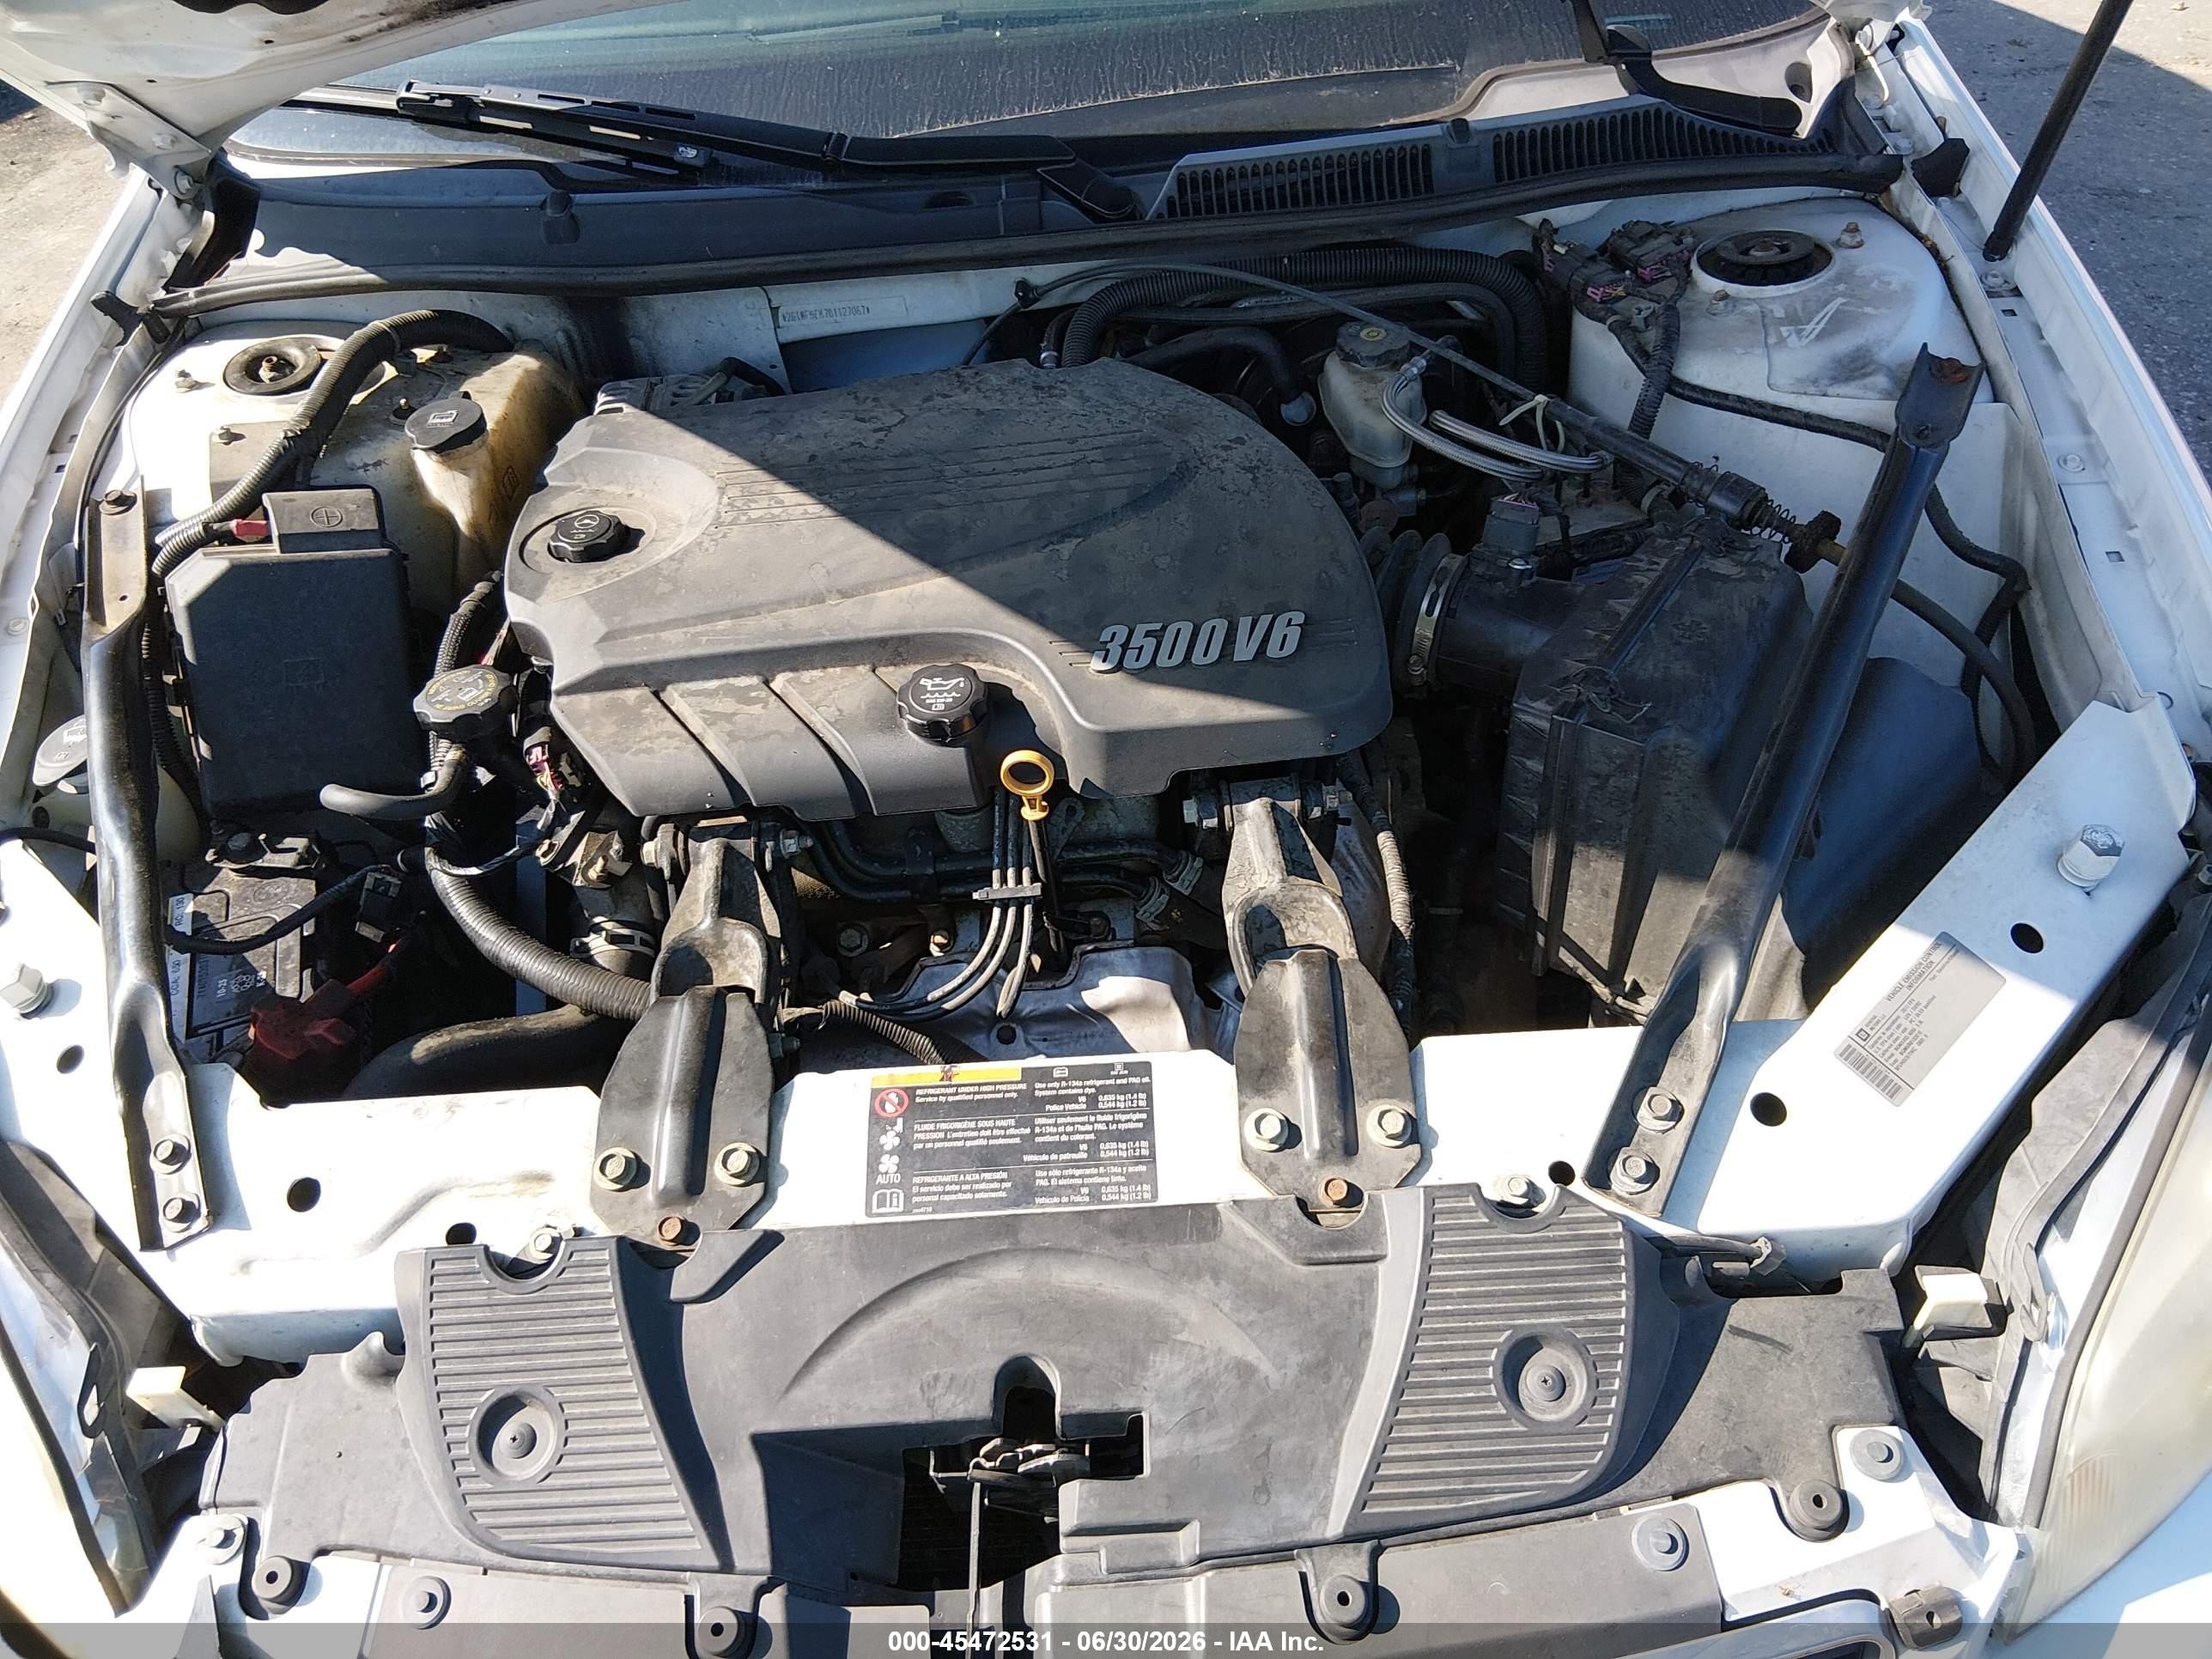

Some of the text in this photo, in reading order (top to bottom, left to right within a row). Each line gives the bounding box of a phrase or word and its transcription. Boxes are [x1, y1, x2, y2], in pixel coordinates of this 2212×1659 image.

[1090, 611, 1305, 672] 3500 V6
[176, 896, 185, 910] 130
[1885, 982, 1905, 1002] VEHICLE
[1901, 960, 1924, 984] EMISSION
[1920, 940, 1942, 963] CONTROL
[1905, 959, 1935, 991] INFORMATION
[934, 1139, 963, 1149] personnel
[913, 1175, 958, 1183] REFRIGERANTE
[981, 1170, 1007, 1180] PRESIÓN
[1062, 1168, 1098, 1176] refrigerante
[876, 1174, 901, 1184] AUTO
[912, 1194, 939, 1203] personal
[940, 1192, 973, 1200] capacitado
